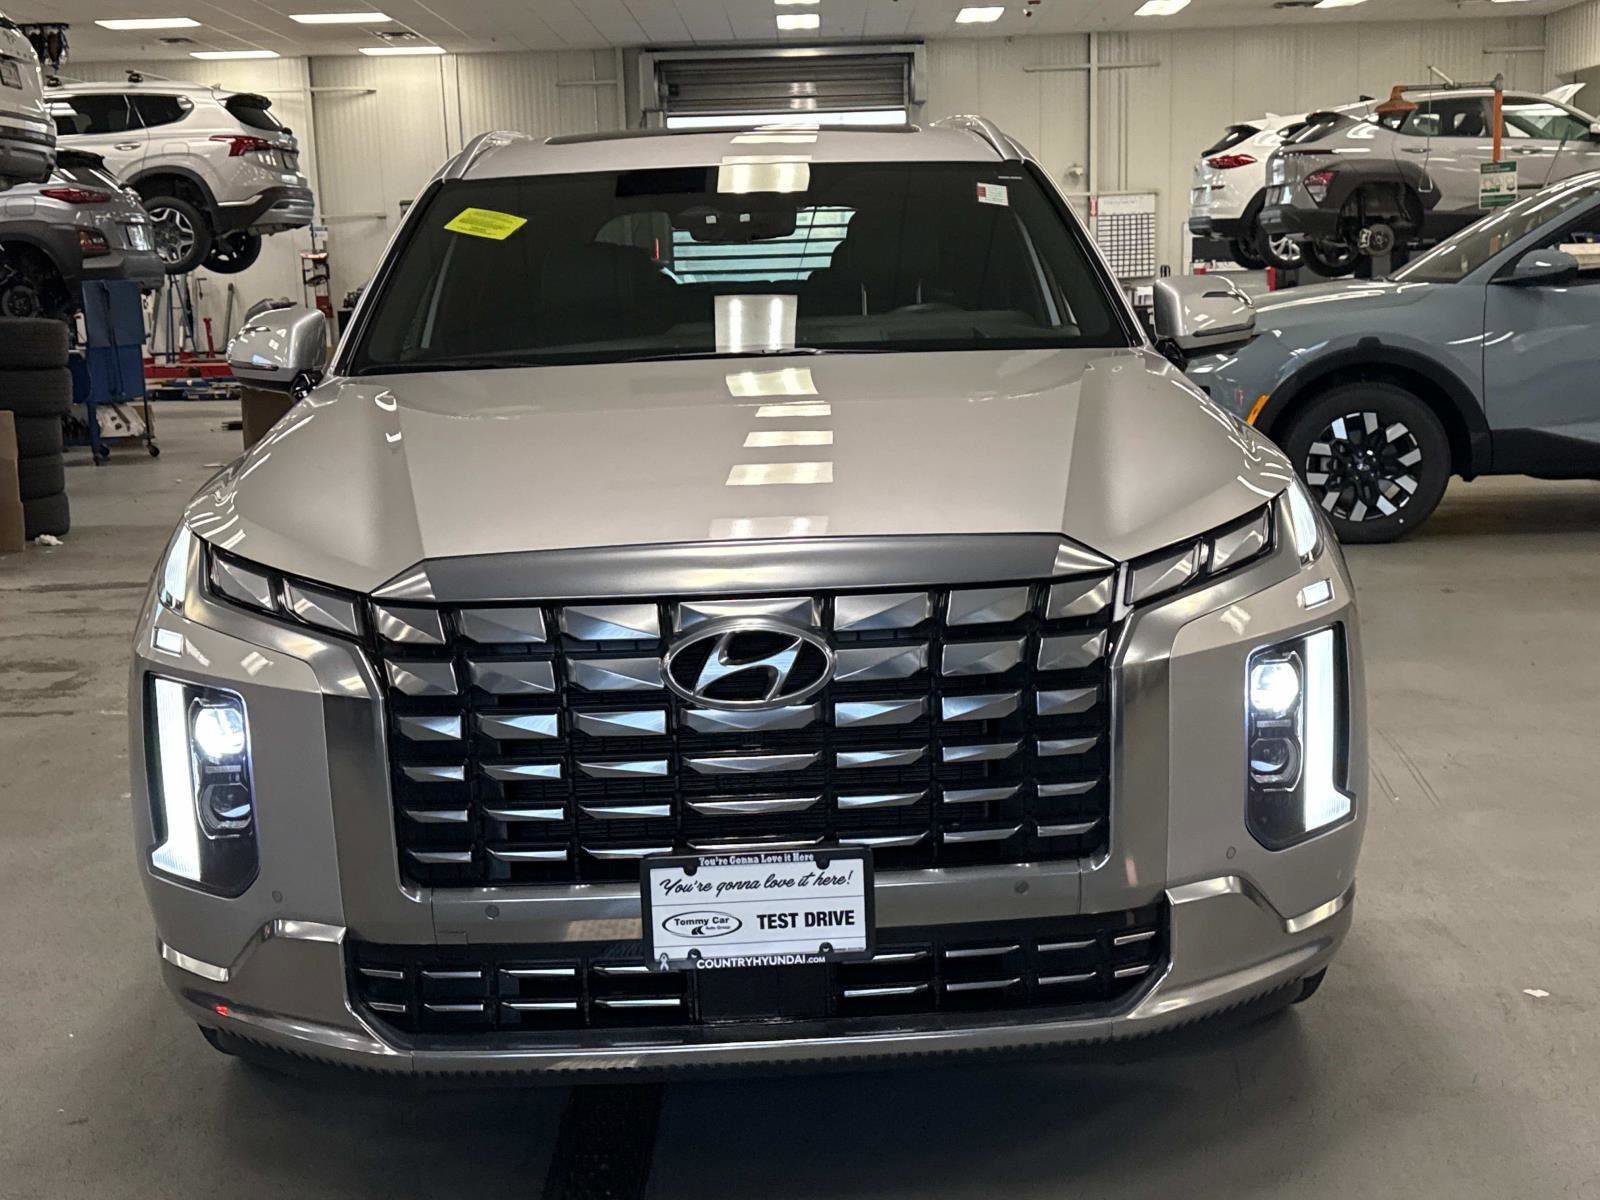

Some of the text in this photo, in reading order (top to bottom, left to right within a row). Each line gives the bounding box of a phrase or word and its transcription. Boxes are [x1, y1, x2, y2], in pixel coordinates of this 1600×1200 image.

[699, 852, 814, 866] You're Gonna Love it Here
[659, 870, 854, 898] You're gonna love it here!
[674, 916, 730, 926] Tommy Car
[757, 909, 855, 930] TEST DRIVE
